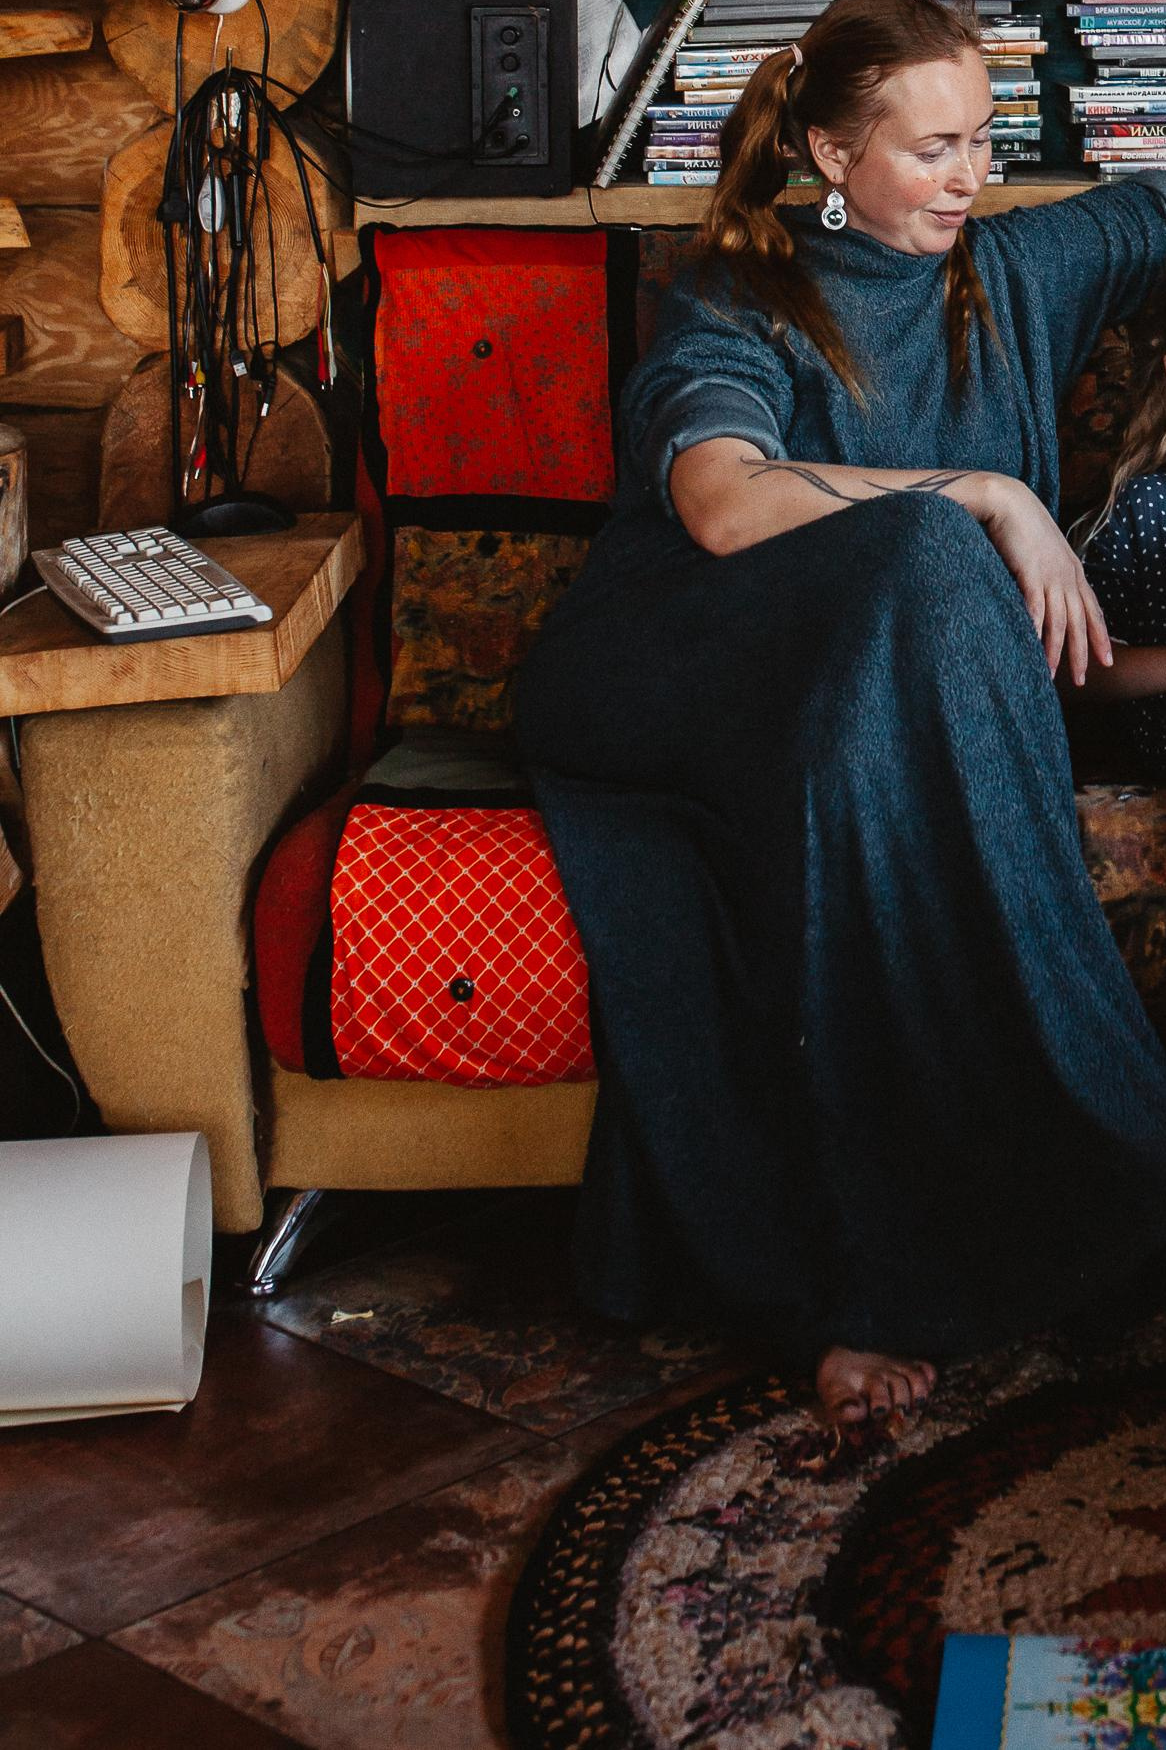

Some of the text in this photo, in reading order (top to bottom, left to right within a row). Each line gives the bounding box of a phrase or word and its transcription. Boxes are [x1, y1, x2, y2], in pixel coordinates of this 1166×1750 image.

[1095, 4, 1164, 15] ВРЕМЯ ПРОЩАНИЯ
[684, 108, 712, 116] НОЧЬ
